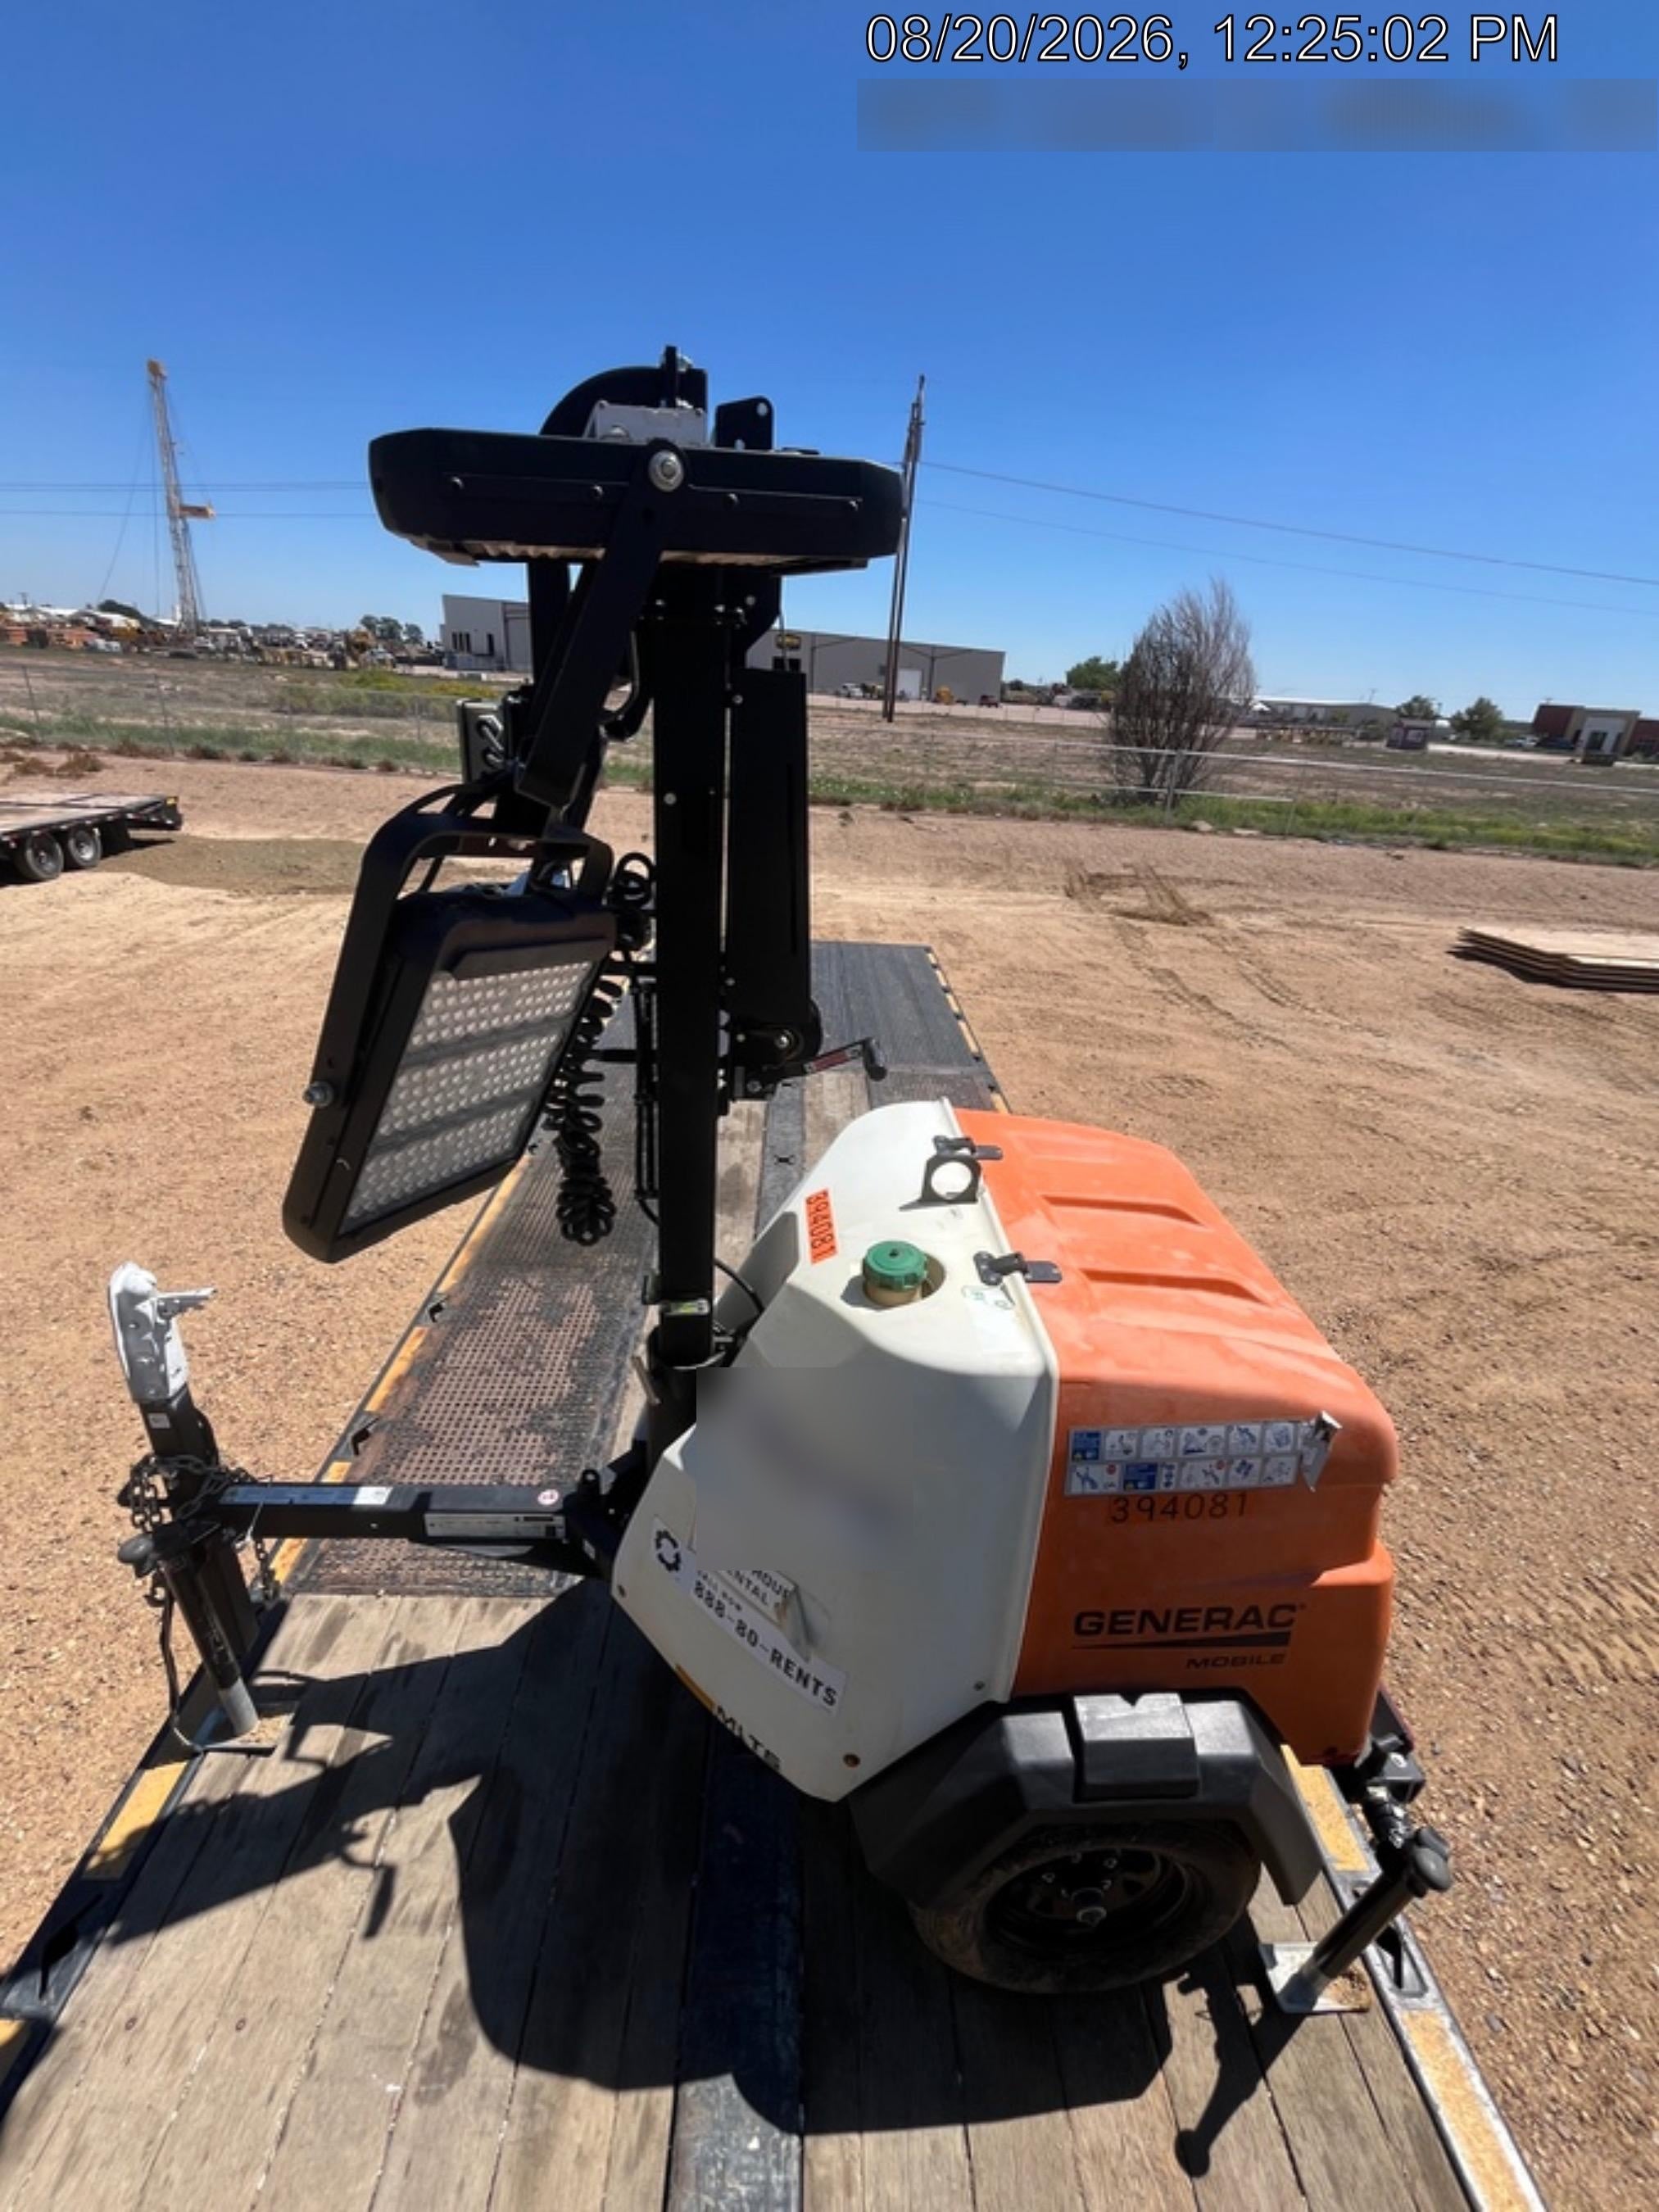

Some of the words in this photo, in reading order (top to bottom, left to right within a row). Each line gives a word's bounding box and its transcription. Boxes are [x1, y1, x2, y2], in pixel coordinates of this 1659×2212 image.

[806, 1190, 836, 1262] 394081
[1111, 1491, 1247, 1524] 394081
[1074, 1604, 1296, 1636] GENERAC
[1186, 1654, 1285, 1669] MOBILE
